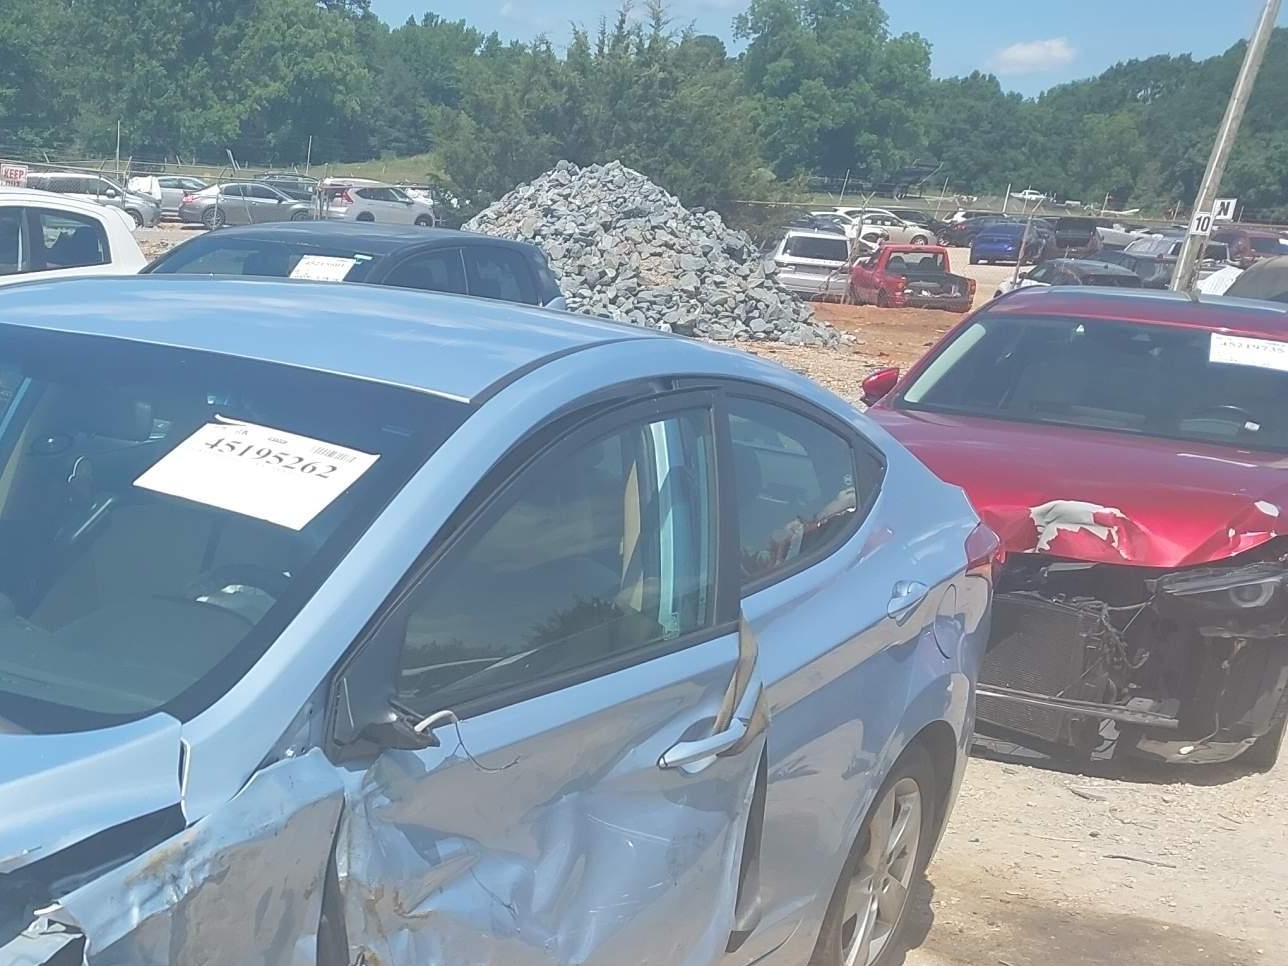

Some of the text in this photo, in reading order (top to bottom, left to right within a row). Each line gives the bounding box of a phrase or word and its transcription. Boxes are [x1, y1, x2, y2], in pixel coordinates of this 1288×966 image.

[3, 167, 25, 180] KEEP
[1217, 201, 1231, 216] N
[1195, 215, 1211, 232] 10
[204, 438, 337, 479] 45195262
